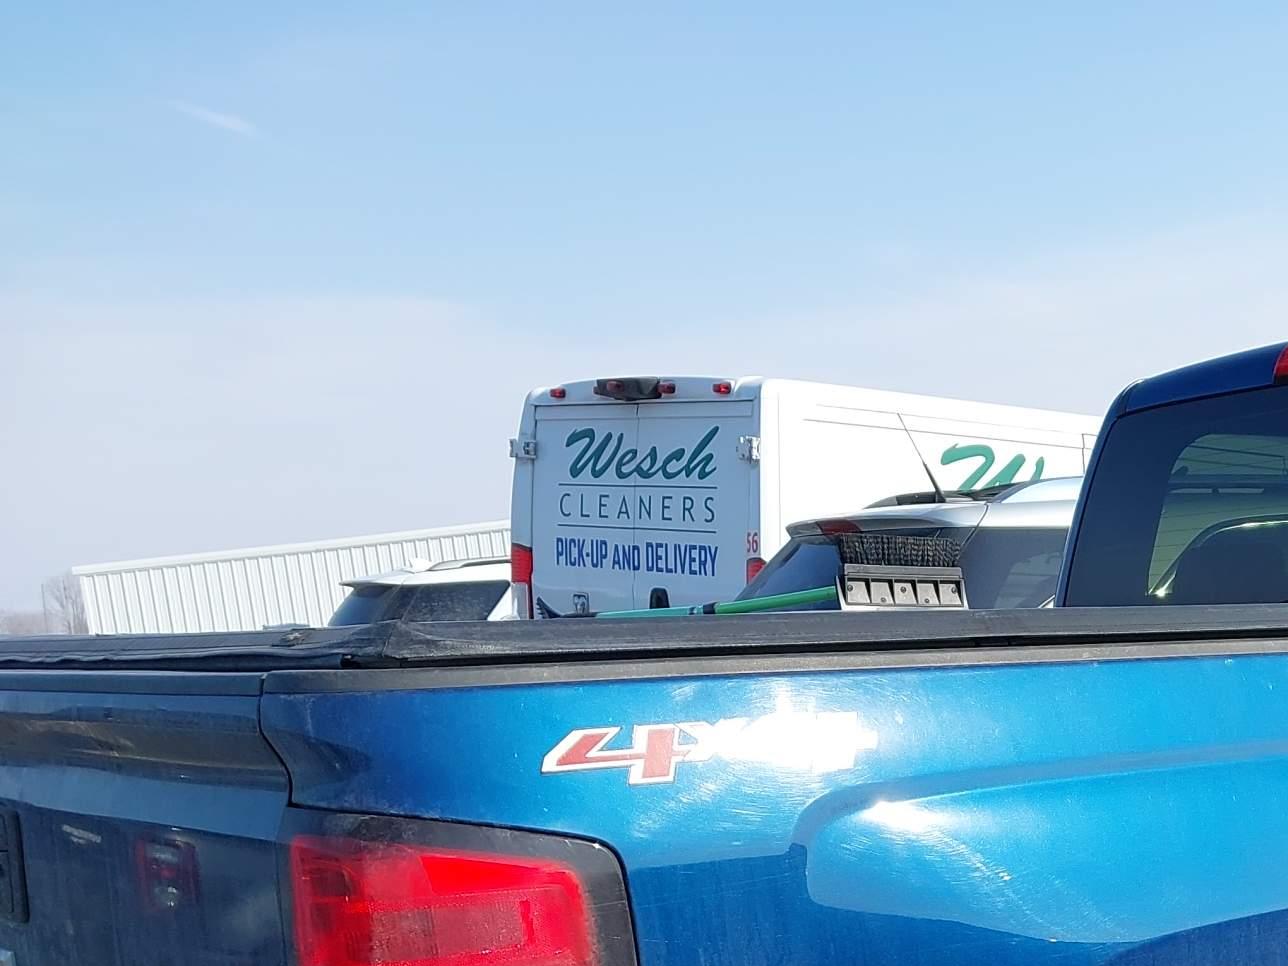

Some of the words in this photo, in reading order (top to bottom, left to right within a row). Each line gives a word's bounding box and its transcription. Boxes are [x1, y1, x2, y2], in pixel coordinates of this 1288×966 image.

[565, 425, 720, 480] Wesch
[559, 493, 716, 523] CLEANERS
[556, 536, 609, 569] PICK-UP
[611, 543, 641, 571] AND
[645, 541, 719, 577] DELIVERY
[746, 531, 760, 553] 56
